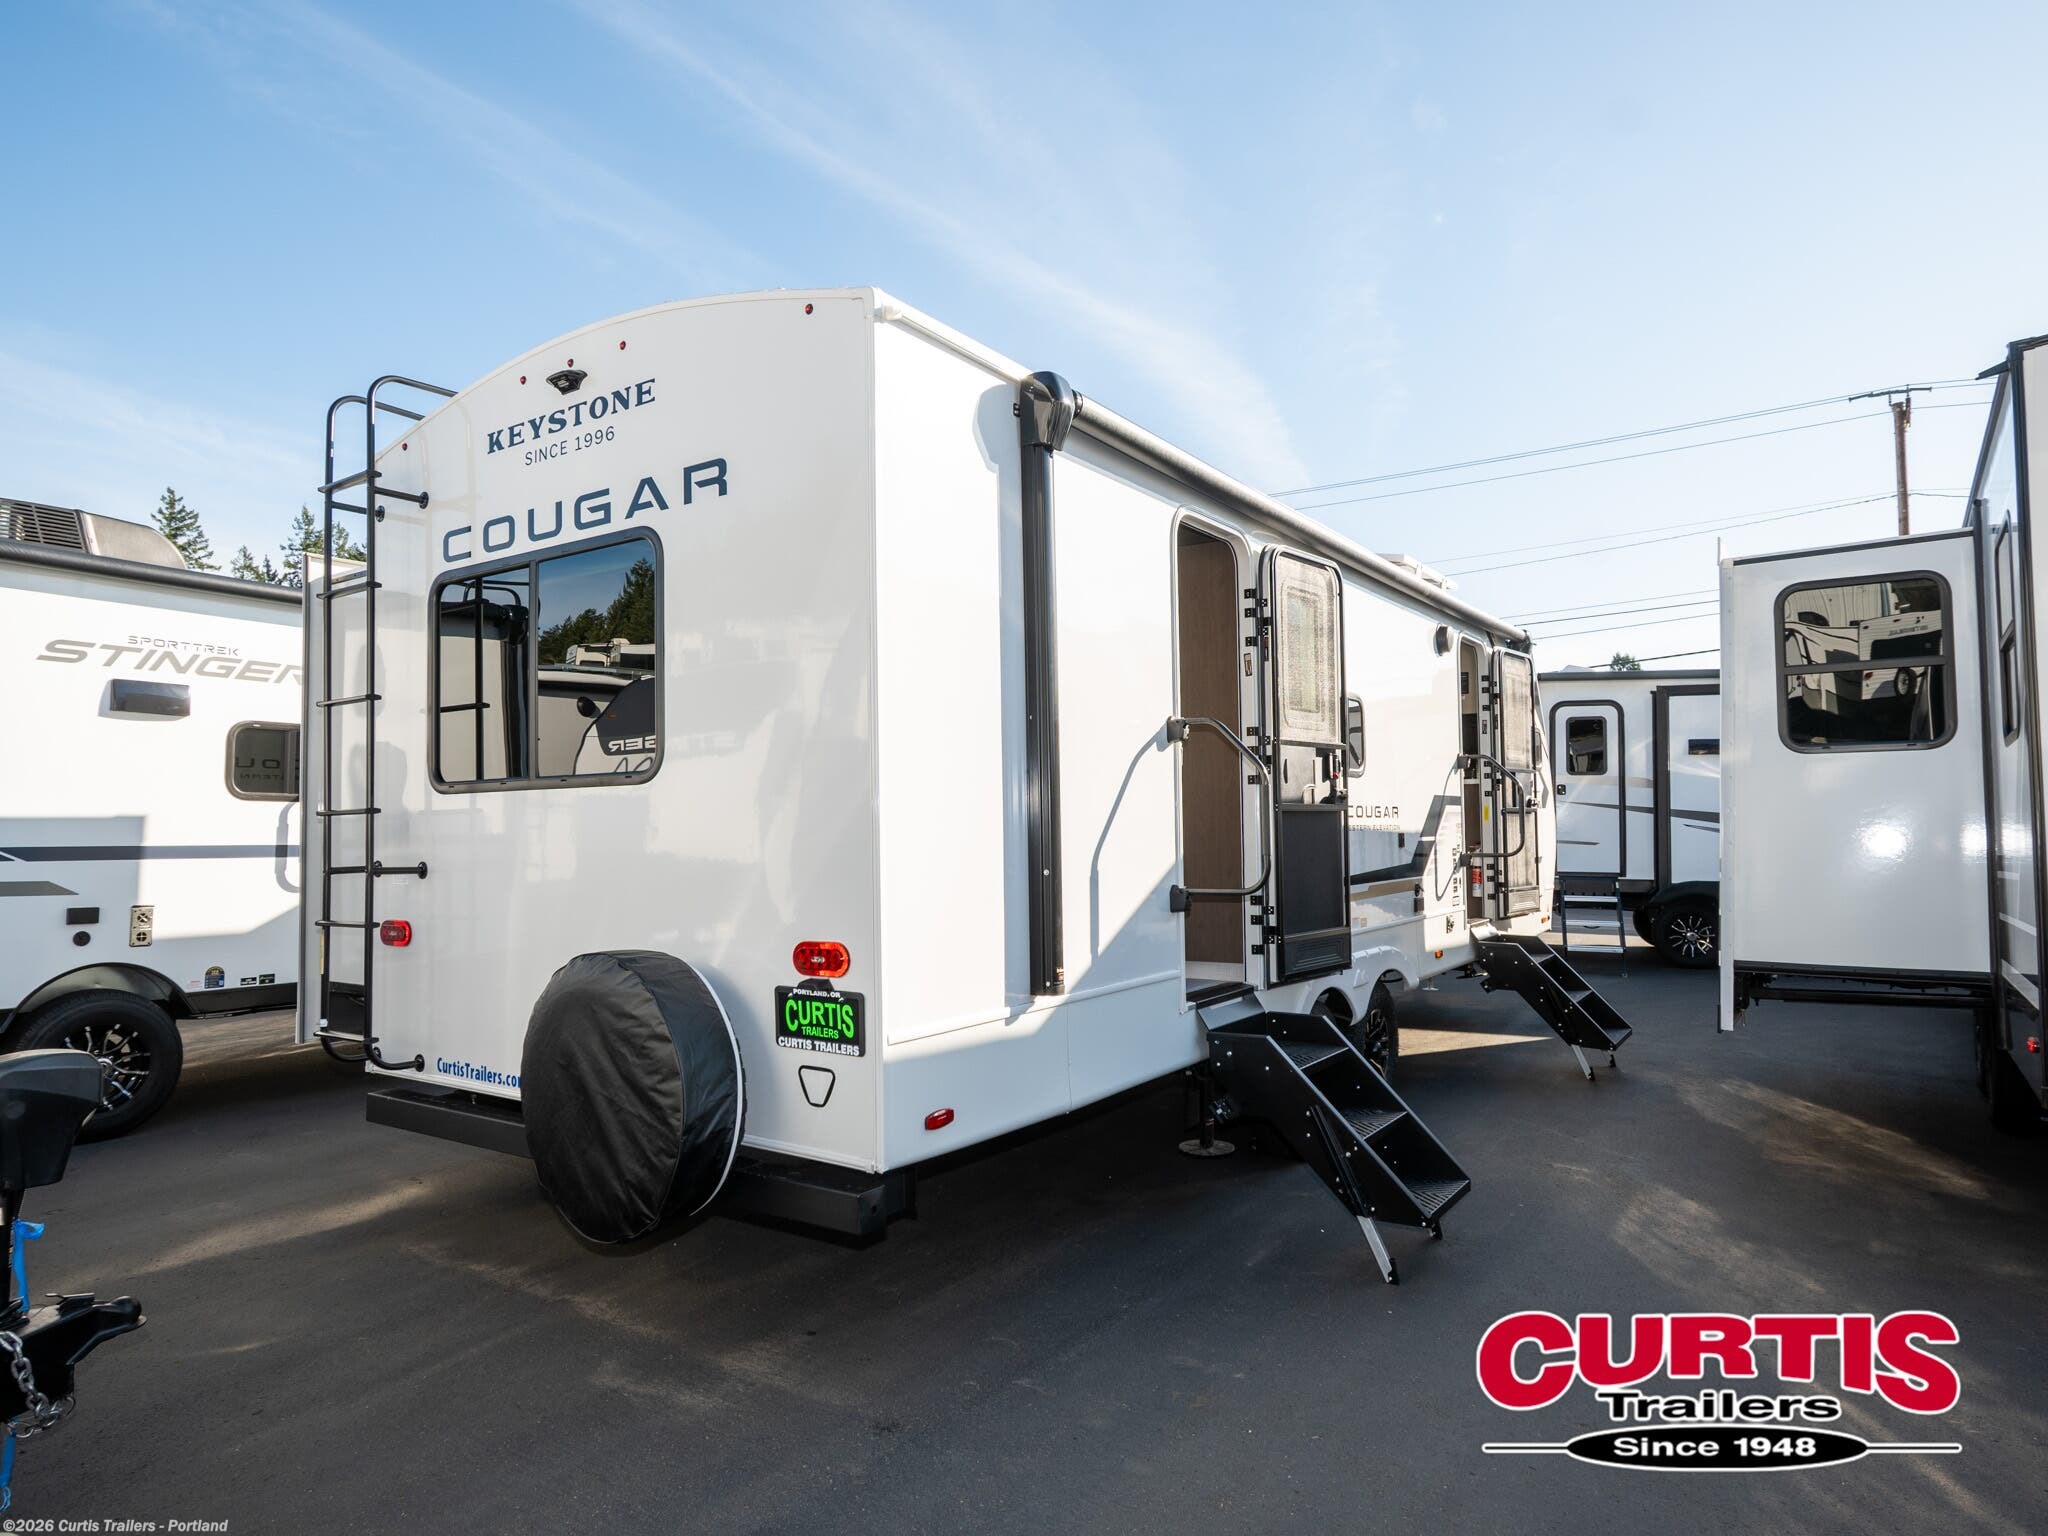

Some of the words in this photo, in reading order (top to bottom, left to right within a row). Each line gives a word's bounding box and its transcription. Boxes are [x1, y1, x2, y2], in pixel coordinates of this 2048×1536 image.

[487, 378, 656, 454] KEYSTONE
[524, 440, 569, 466] SINCE
[574, 425, 616, 452] 1996
[443, 457, 728, 563] COUGAR
[128, 635, 240, 657] SPORTTREK
[830, 991, 841, 999] OR
[785, 999, 854, 1038] CURTIS
[801, 1026, 839, 1039] TRAILERS
[778, 1036, 812, 1050] CURTIS
[813, 1040, 860, 1056] TRAILERS
